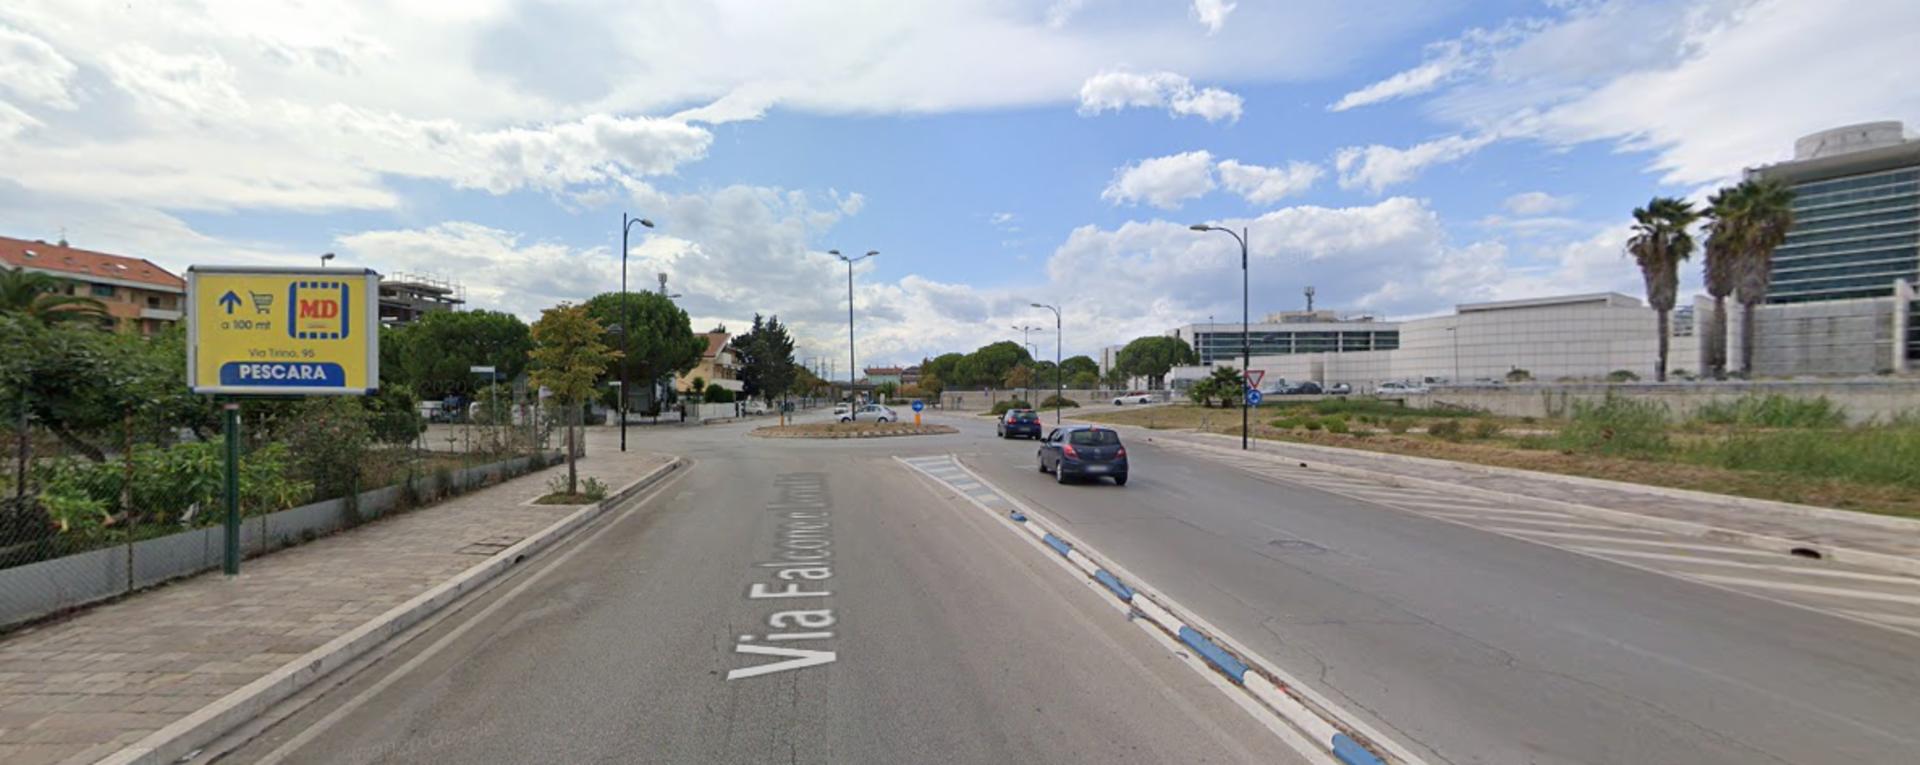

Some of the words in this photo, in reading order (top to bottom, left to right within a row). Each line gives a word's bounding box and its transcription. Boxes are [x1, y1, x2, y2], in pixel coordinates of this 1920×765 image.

[299, 299, 339, 319] MD
[221, 321, 229, 330] a
[233, 320, 253, 329] 100
[255, 320, 271, 329] mt
[248, 348, 266, 358] Via
[301, 349, 316, 358] 95
[239, 365, 327, 380] PESCARA
